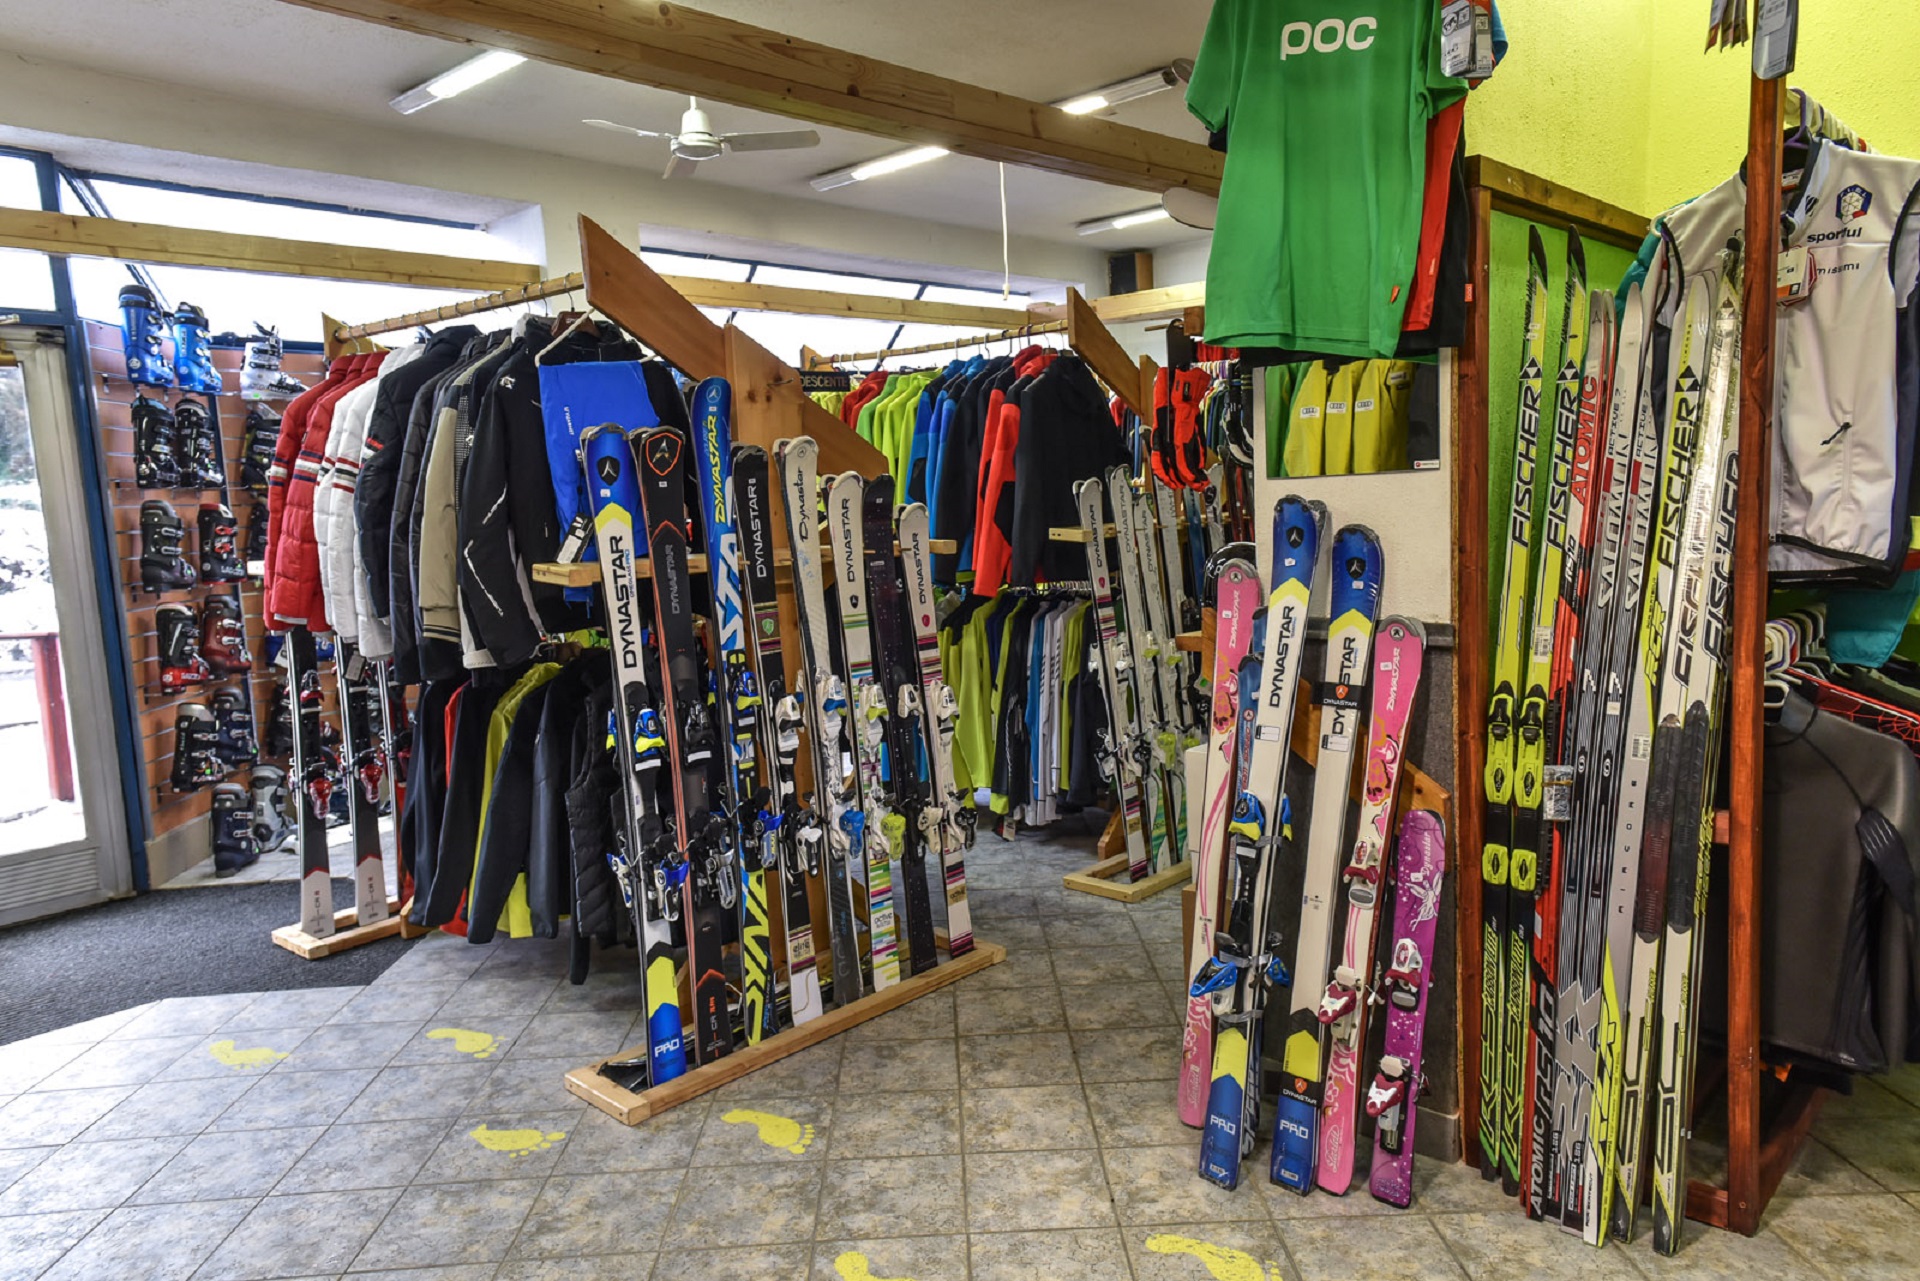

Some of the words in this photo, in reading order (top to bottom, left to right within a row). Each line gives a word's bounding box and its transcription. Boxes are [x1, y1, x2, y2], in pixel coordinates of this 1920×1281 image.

[1570, 375, 1597, 508] ATOMIC
[1608, 402, 1621, 455] ACTIVE
[1636, 403, 1648, 457] ACTIVE
[708, 415, 726, 523] DYNASTAR
[1512, 384, 1542, 548] FISCHER
[1546, 385, 1578, 553] FISCHER
[1657, 396, 1698, 570] FISCHER
[748, 488, 766, 578] DYNASTAR
[796, 467, 810, 542] Dynastar
[1089, 504, 1102, 567] DYNASTAR
[1119, 485, 1132, 553] DYNASTAR
[842, 498, 855, 582] DYNASTAR
[912, 533, 926, 604] DYNASTAR
[1140, 509, 1153, 573] DYNASTAR
[609, 535, 637, 669] DYNASTAR
[664, 544, 681, 615] DYNASTAR
[1229, 589, 1240, 648] DYNASTAR
[1269, 605, 1294, 708] DYNASTAR
[1387, 647, 1401, 712] DYNASTAR
[1323, 697, 1358, 707] DYNASTAR
[1421, 831, 1431, 878] Dynastar
[792, 938, 810, 953] elite
[873, 913, 893, 925] active
[655, 1038, 680, 1058] PRO
[1210, 1114, 1236, 1135] PRO
[1282, 1088, 1318, 1105] DYNASTAR
[1280, 1120, 1309, 1140] PRO
[1531, 1115, 1545, 1217] ATOMIC
